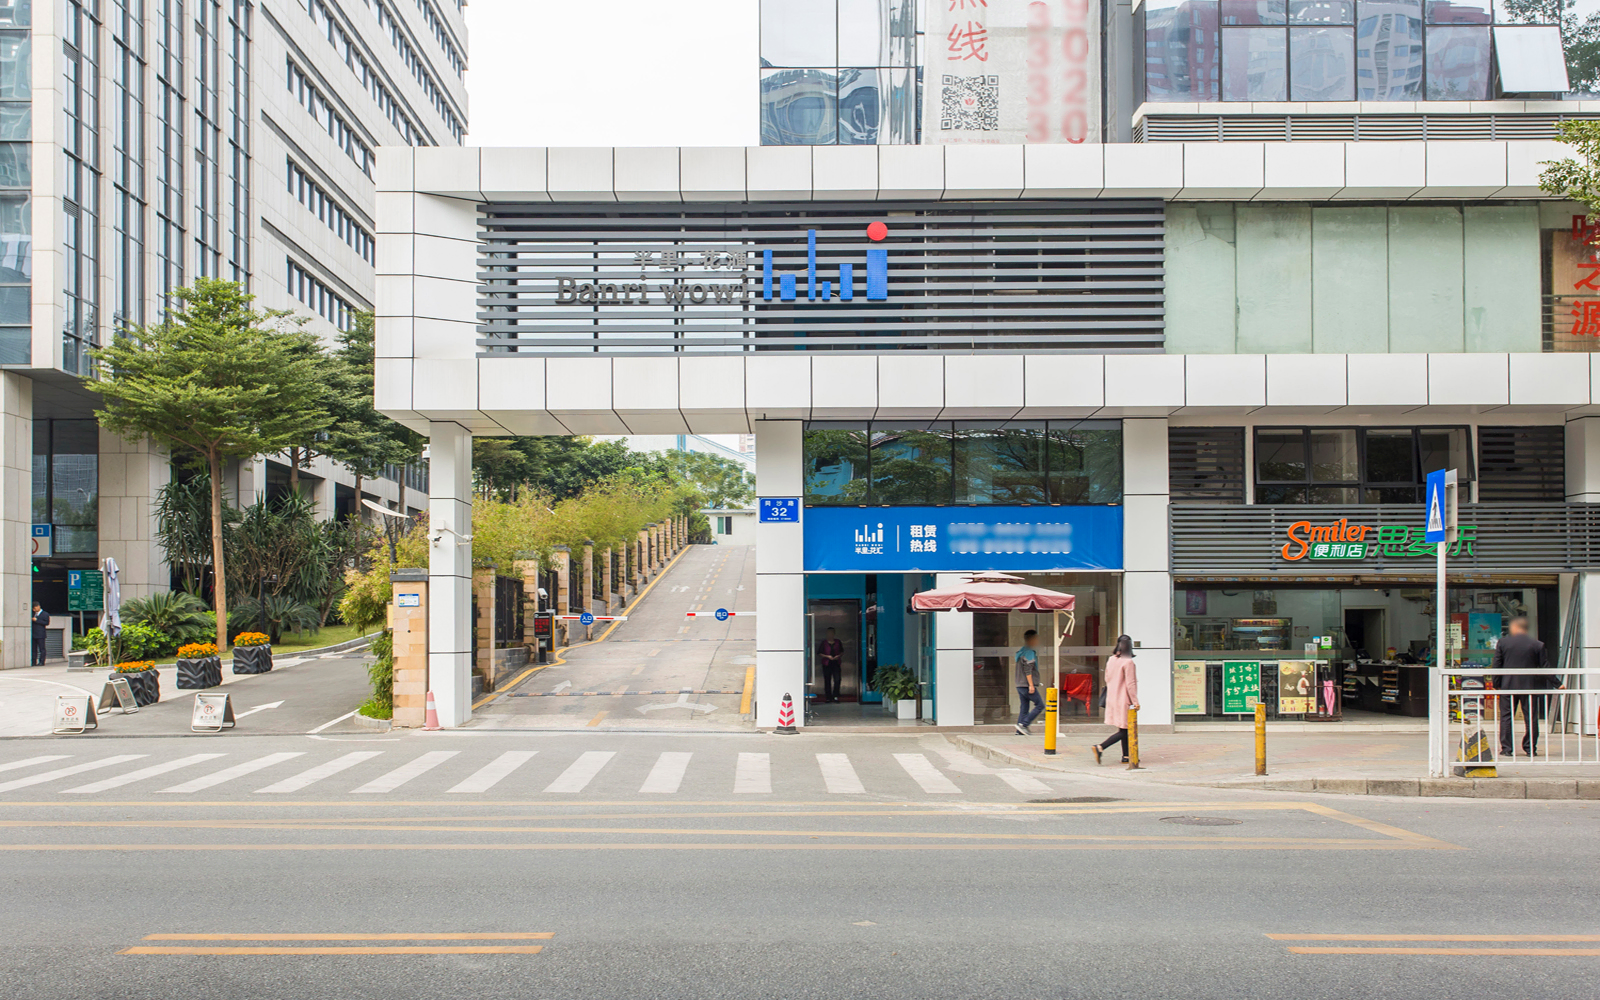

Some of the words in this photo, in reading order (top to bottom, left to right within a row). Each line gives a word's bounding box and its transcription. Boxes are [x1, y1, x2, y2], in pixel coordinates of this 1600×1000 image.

[947, 0, 989, 62] 线
[555, 274, 649, 304] Banri
[659, 273, 750, 304] wowi
[771, 507, 788, 517] 32
[910, 524, 937, 538] 租赁
[910, 539, 937, 553] 热线
[1281, 518, 1372, 560] Smiler
[1313, 543, 1364, 558] 便利店
[70, 573, 80, 586] P
